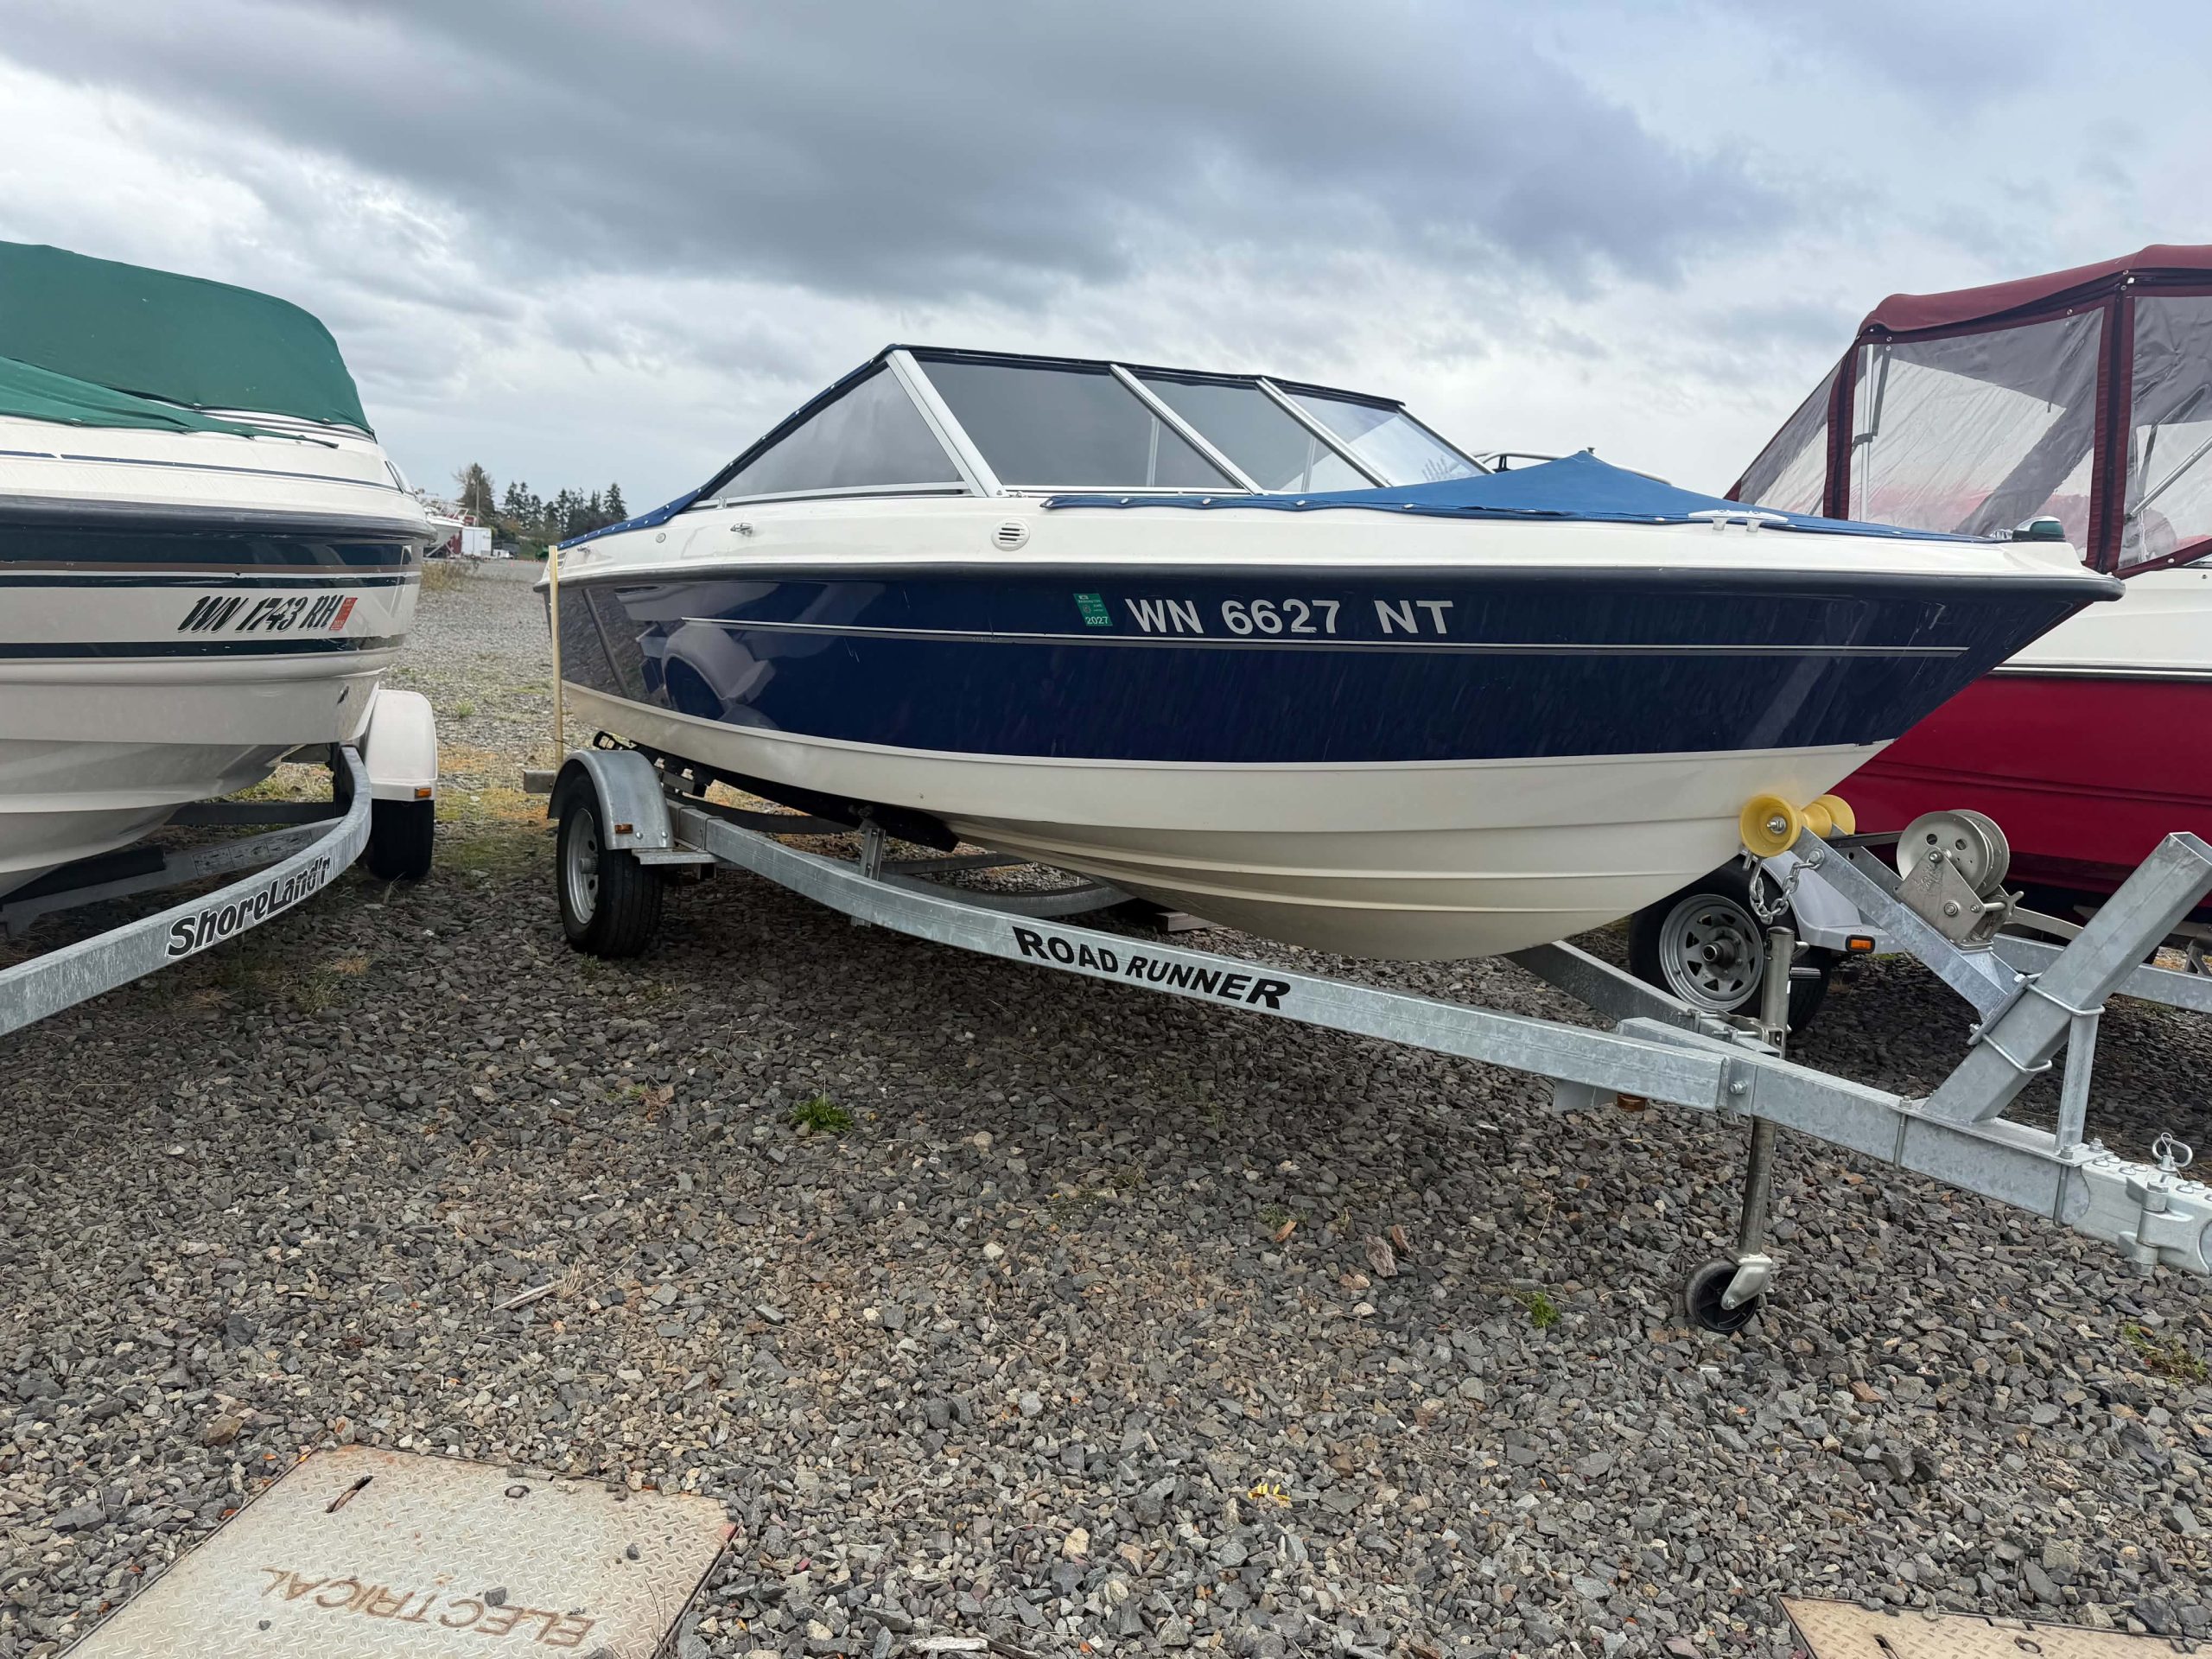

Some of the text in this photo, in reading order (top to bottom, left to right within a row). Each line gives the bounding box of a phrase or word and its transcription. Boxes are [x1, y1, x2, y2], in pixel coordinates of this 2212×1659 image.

[177, 594, 345, 633] WN 1743 RH
[1085, 616, 1109, 625] 2027
[1124, 598, 1454, 635] WN 6627 NT
[165, 855, 331, 959] ShoreLand'r
[1012, 925, 1291, 1010] ROAD RUNNER
[260, 1567, 596, 1648] ELECTRICAL
